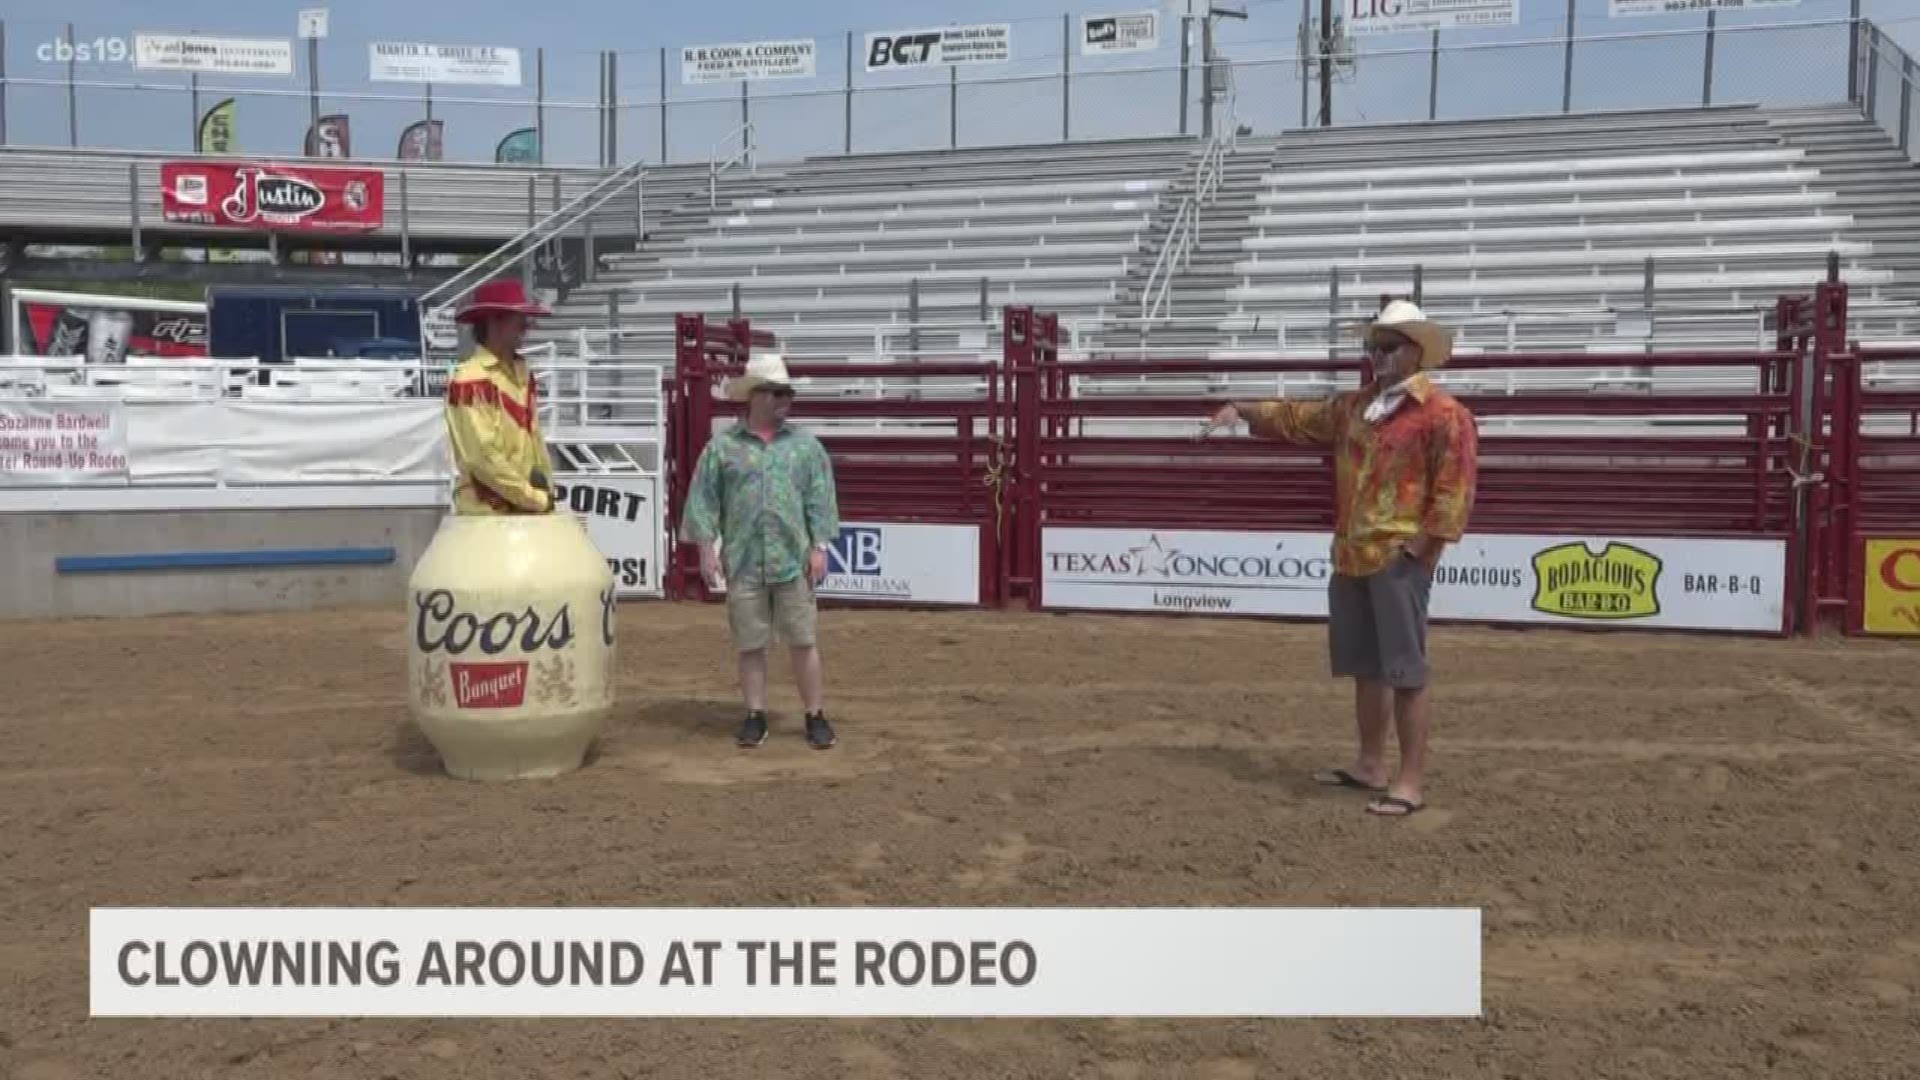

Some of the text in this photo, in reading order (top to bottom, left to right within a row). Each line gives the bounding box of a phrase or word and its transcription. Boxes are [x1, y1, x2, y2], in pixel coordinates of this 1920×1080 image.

[710, 47, 742, 61] COOK
[755, 44, 812, 56] COMPANY
[222, 168, 317, 222] Justin
[56, 412, 110, 430] Bardwell
[34, 436, 56, 451] you
[60, 434, 73, 449] to
[77, 432, 98, 450] the
[89, 452, 127, 469] Rodeo
[553, 484, 647, 522] PORT
[1050, 551, 1132, 574] TEXAS
[870, 576, 912, 592] BANK
[1430, 565, 1523, 588] ODACIOUS
[1547, 558, 1646, 595] BODACIOUS
[1683, 573, 1761, 596] BAR-B-Q
[1153, 592, 1232, 610] Longview
[416, 588, 575, 655] Coors
[457, 668, 523, 704] Banquet
